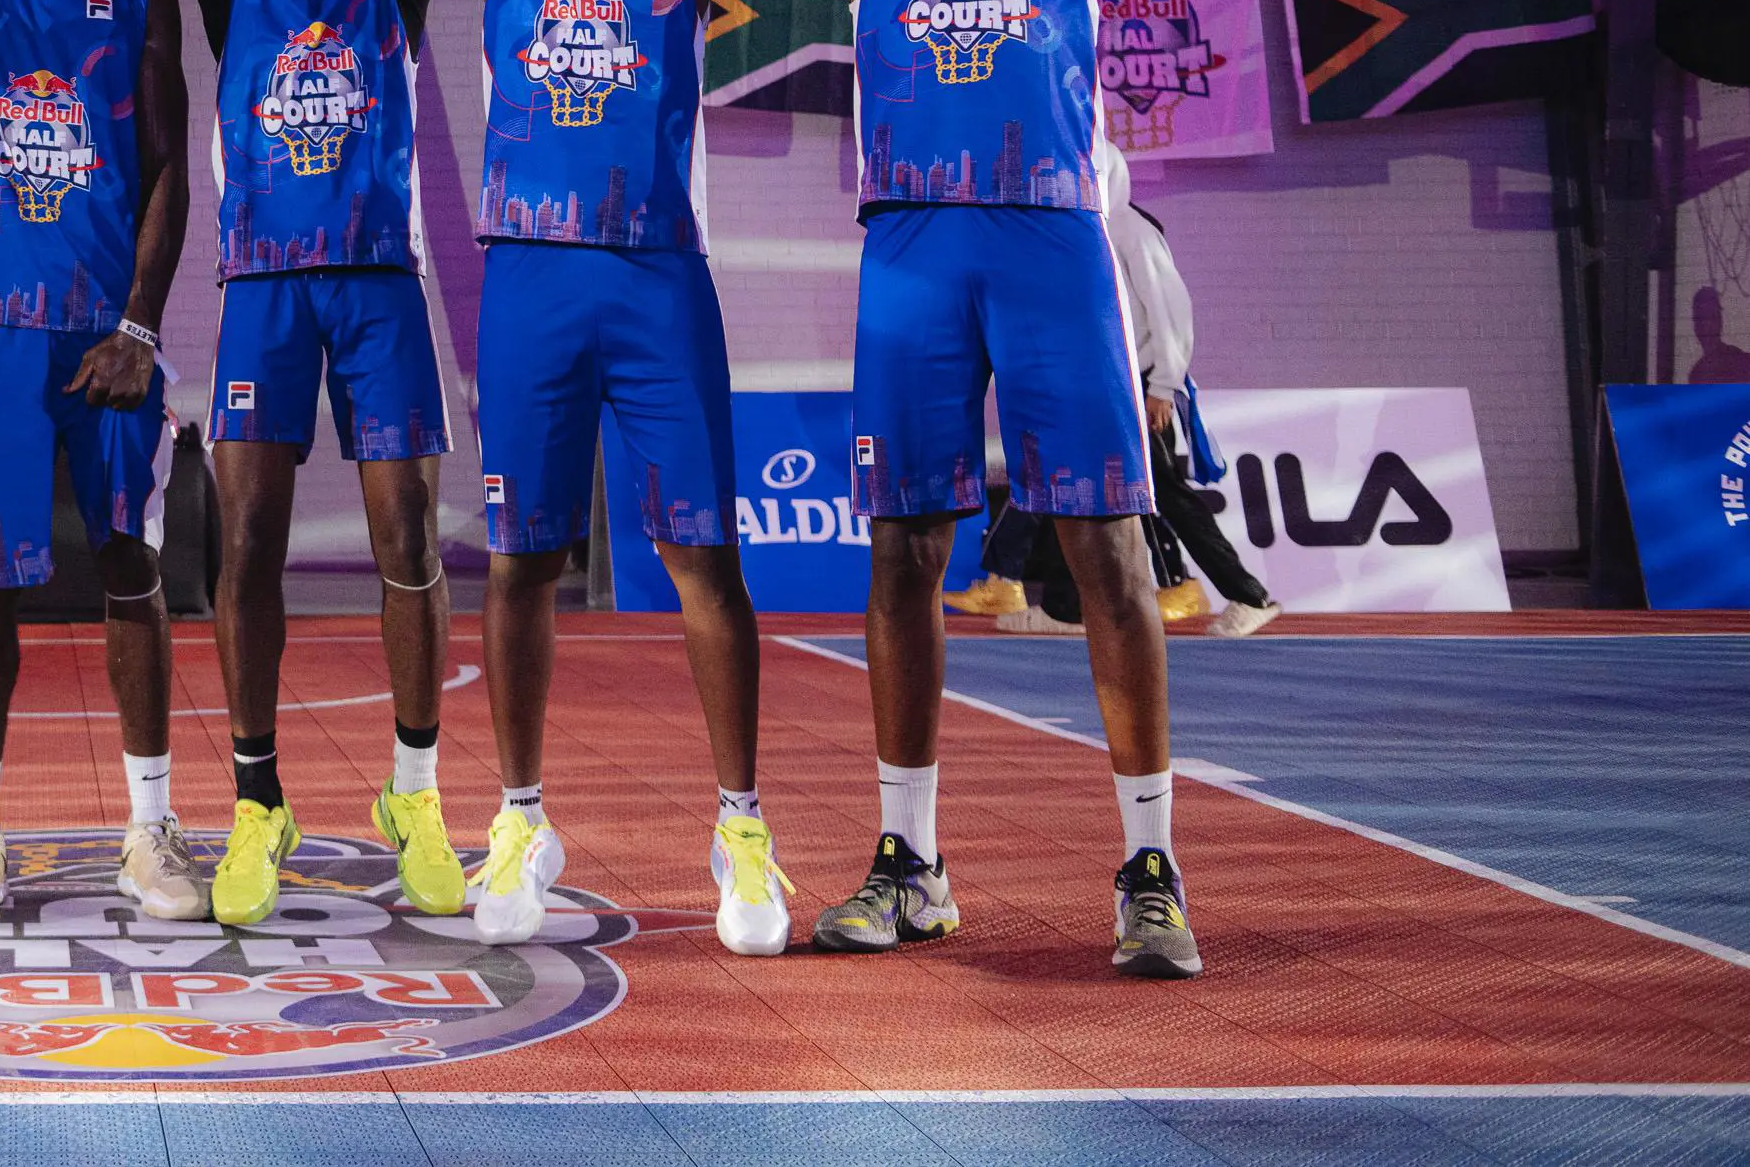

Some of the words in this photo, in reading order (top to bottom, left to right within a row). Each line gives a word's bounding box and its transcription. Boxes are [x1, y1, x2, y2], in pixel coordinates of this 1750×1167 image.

[276, 53, 310, 75] Red
[313, 48, 354, 71] Bull
[528, 41, 635, 85] COURT
[1100, 43, 1209, 98] OURT
[42, 101, 84, 125] Bull
[262, 90, 366, 134] COURT
[1176, 452, 1454, 548] ILA
[1721, 474, 1749, 527] THE
[141, 971, 499, 1008] Red
